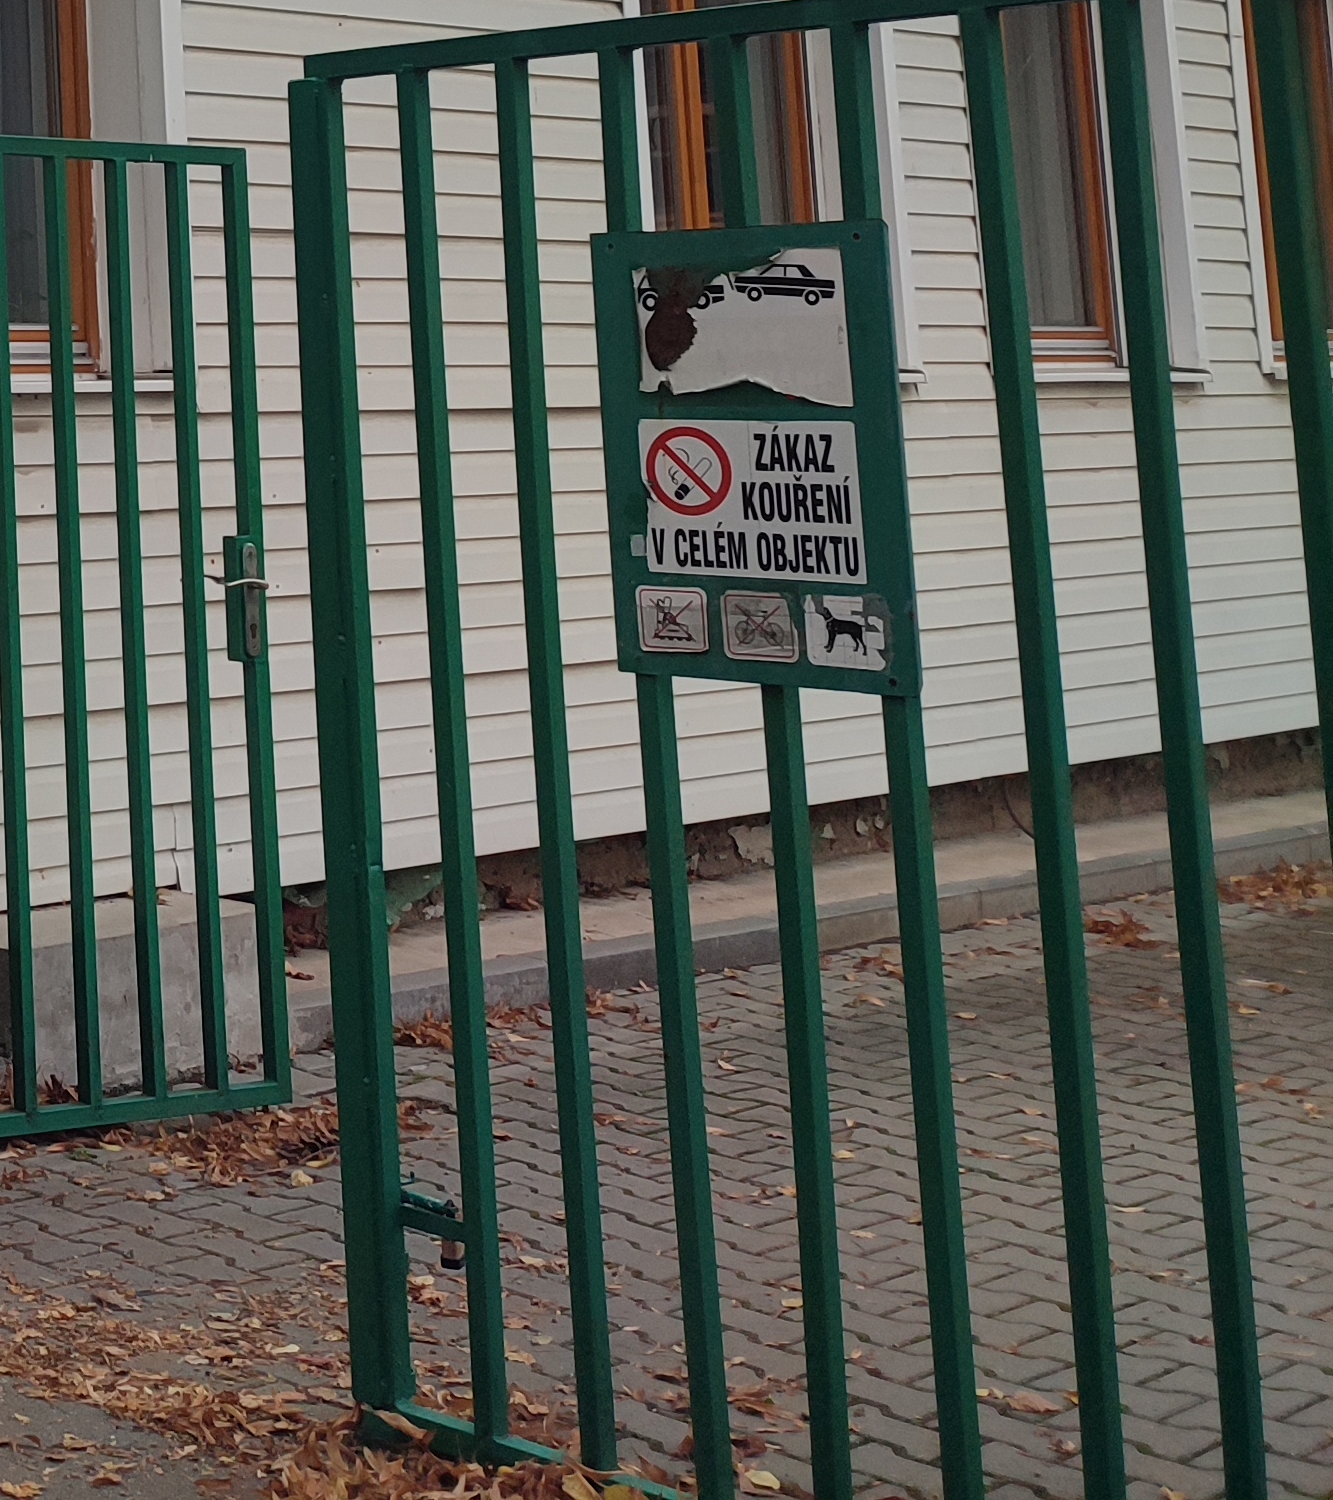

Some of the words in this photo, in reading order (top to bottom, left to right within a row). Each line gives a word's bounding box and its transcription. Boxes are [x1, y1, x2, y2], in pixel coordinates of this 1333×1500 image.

[753, 425, 835, 473] ZÁKAZ
[741, 474, 852, 525] KOUŘENÍ
[651, 528, 664, 565] V
[674, 522, 748, 569] CELÉM
[756, 532, 859, 577] OBJEKTU
